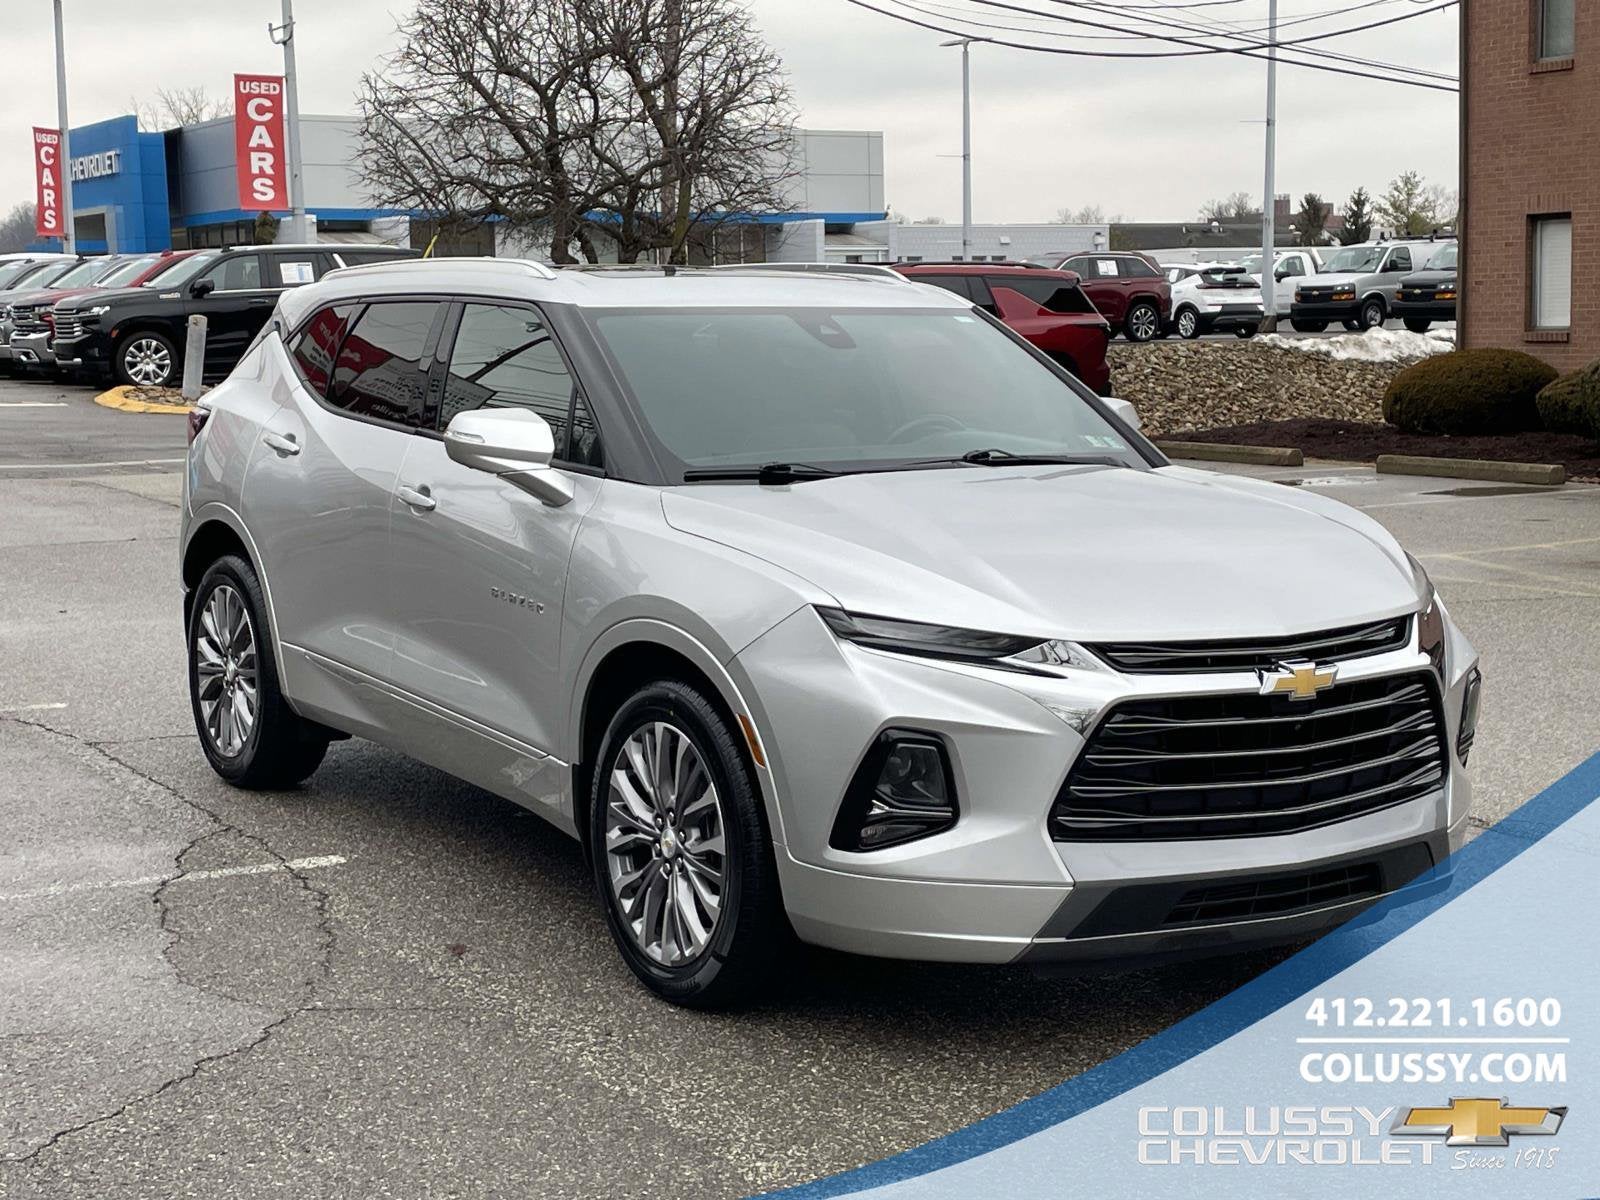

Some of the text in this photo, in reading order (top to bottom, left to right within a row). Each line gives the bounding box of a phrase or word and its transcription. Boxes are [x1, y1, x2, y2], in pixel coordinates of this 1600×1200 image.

[240, 81, 280, 95] USED
[36, 132, 58, 144] USED
[246, 97, 275, 201] CARS
[40, 146, 56, 229] CARS
